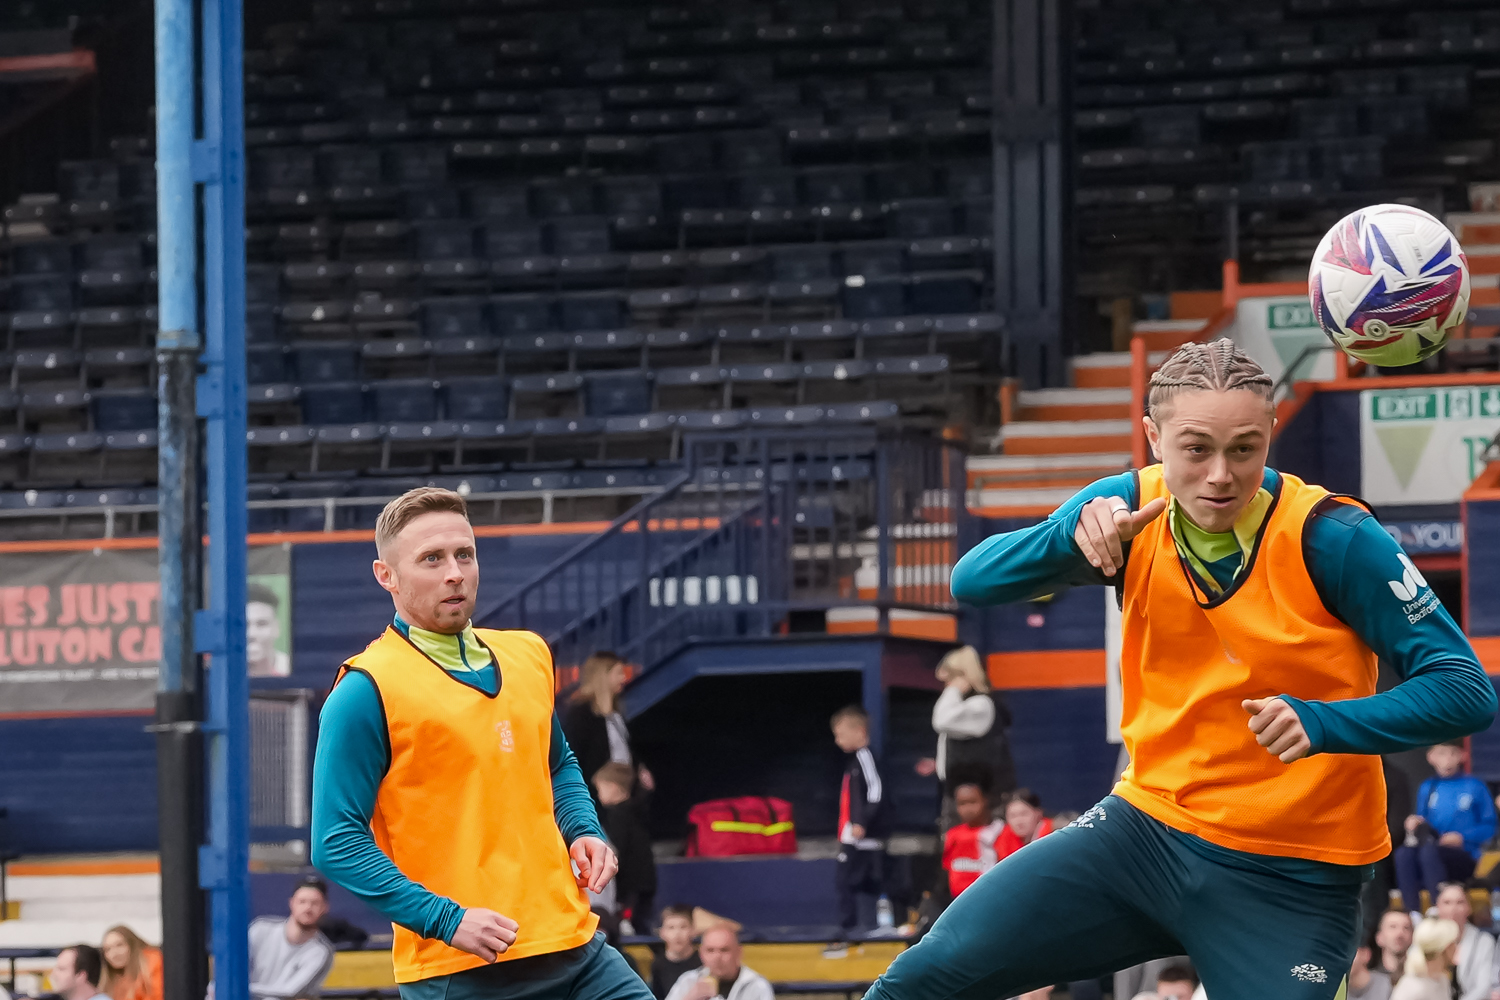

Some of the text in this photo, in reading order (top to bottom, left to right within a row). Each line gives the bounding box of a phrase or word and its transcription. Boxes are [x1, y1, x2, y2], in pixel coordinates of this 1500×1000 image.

[1378, 395, 1430, 419] EXIT
[0, 581, 160, 626] ES JUST
[0, 626, 112, 667] LUTON
